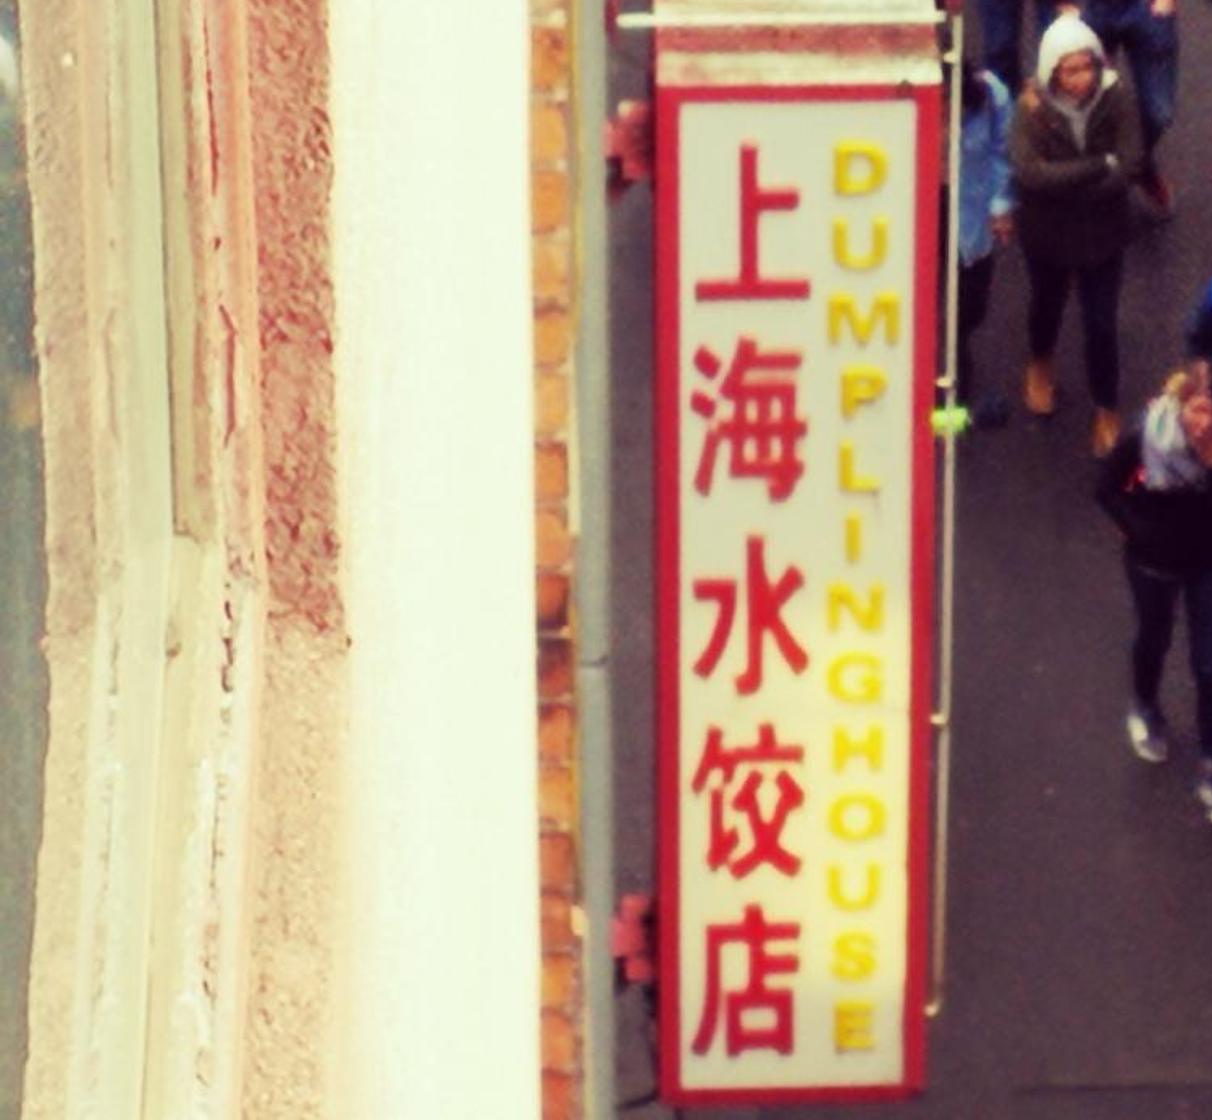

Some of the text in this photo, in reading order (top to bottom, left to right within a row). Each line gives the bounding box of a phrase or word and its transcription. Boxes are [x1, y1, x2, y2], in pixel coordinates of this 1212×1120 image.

[690, 144, 811, 1057] 上海水饺店
